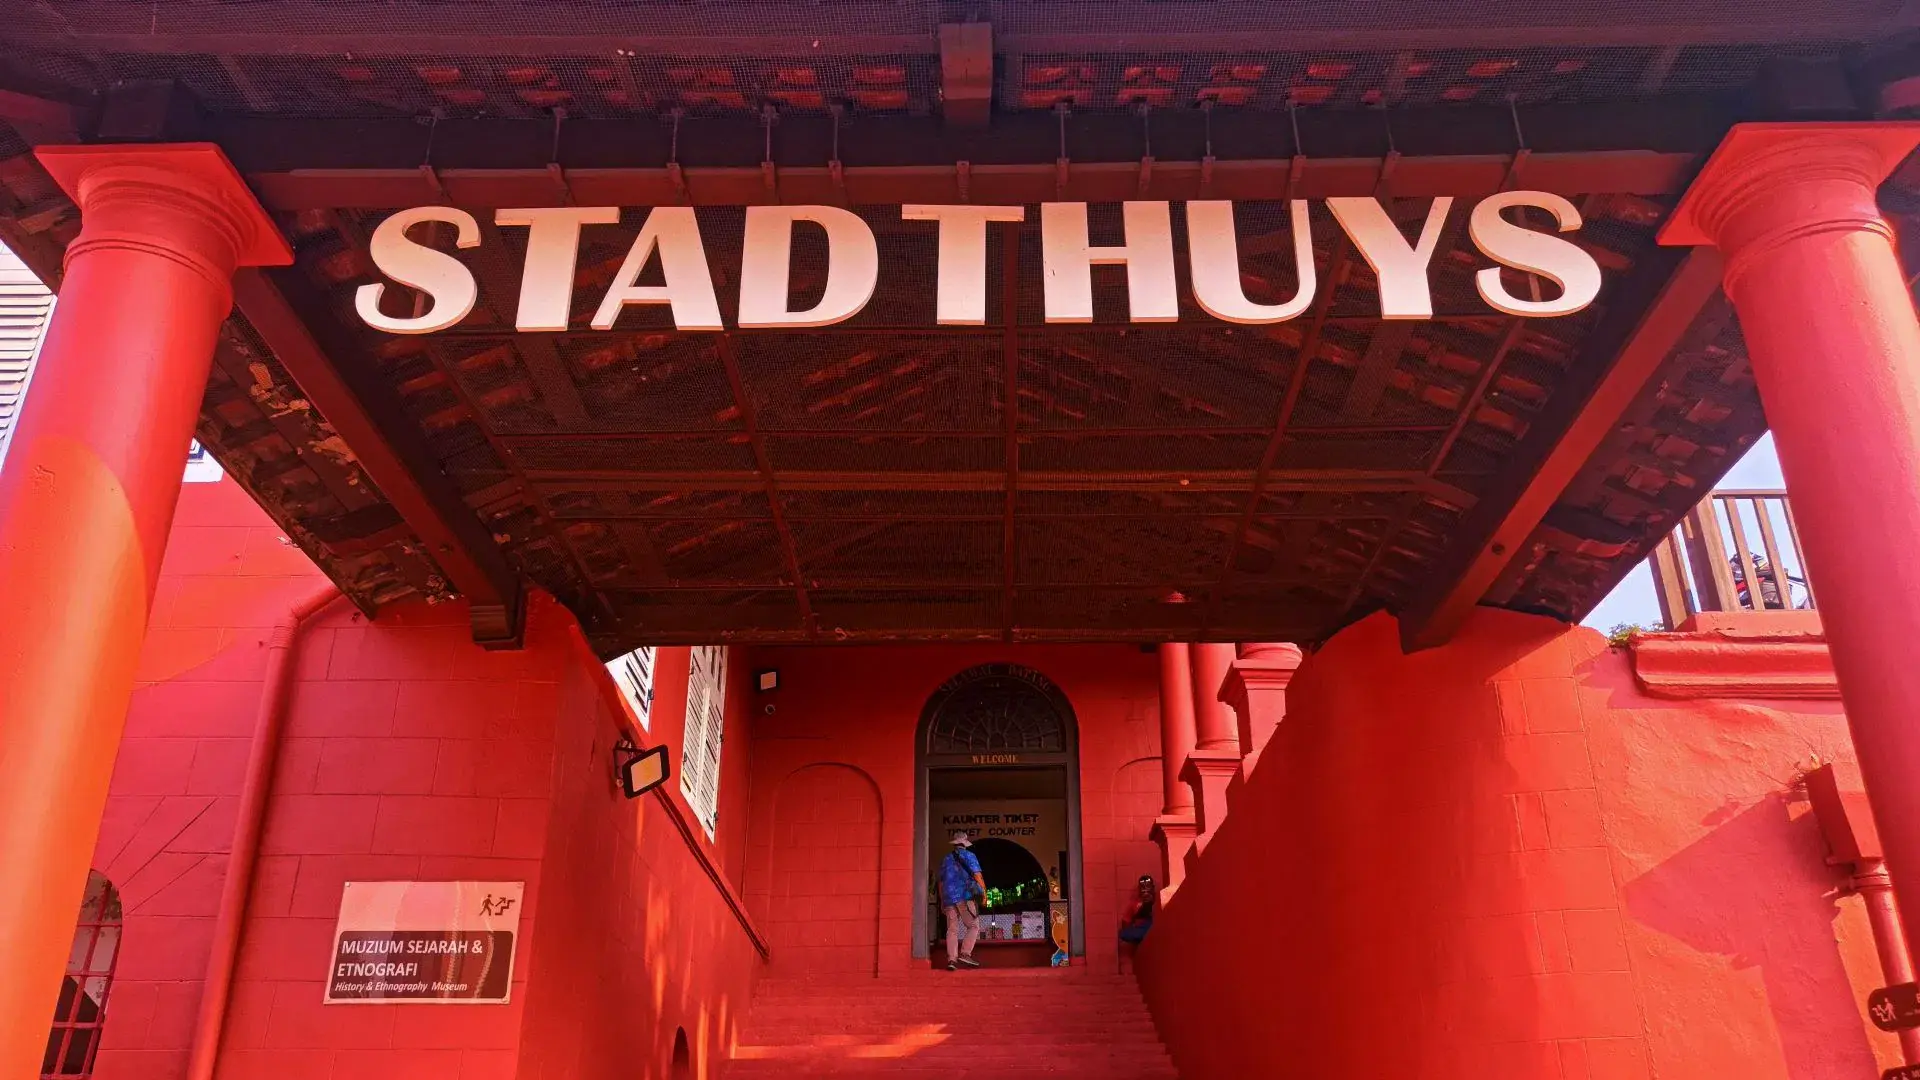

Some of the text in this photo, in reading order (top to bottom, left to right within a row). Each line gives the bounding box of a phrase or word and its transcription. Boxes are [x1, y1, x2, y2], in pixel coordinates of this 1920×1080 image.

[972, 754, 1019, 764] WELCOME
[943, 813, 1039, 824] KAUNTER TIKET
[988, 827, 1035, 836] COUNTER
[341, 940, 483, 954] MUZIUM SEJARAH &
[337, 963, 418, 977] ETNOGRAFI
[335, 982, 468, 993] History & Ethnography Museum
